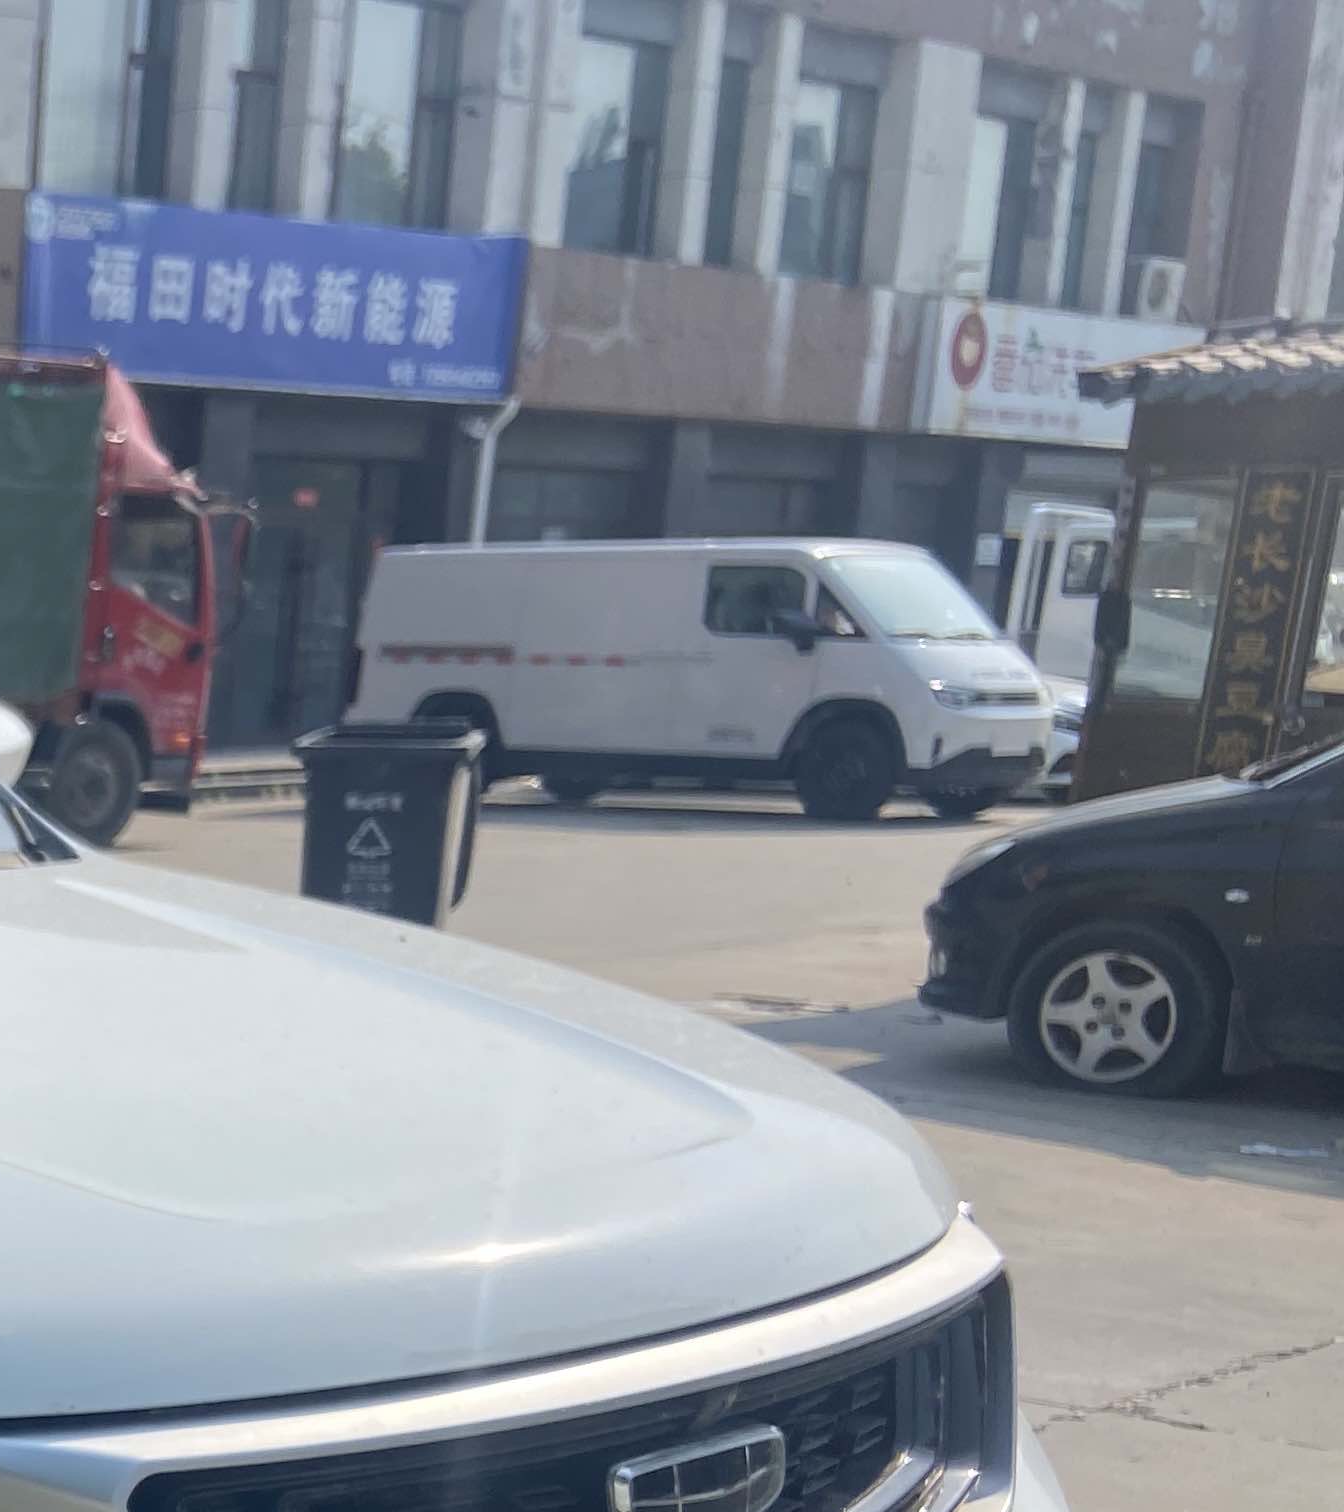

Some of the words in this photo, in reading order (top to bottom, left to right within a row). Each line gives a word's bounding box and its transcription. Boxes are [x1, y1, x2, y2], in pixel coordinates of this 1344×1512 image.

[86, 242, 461, 350] 福田时代新能源
